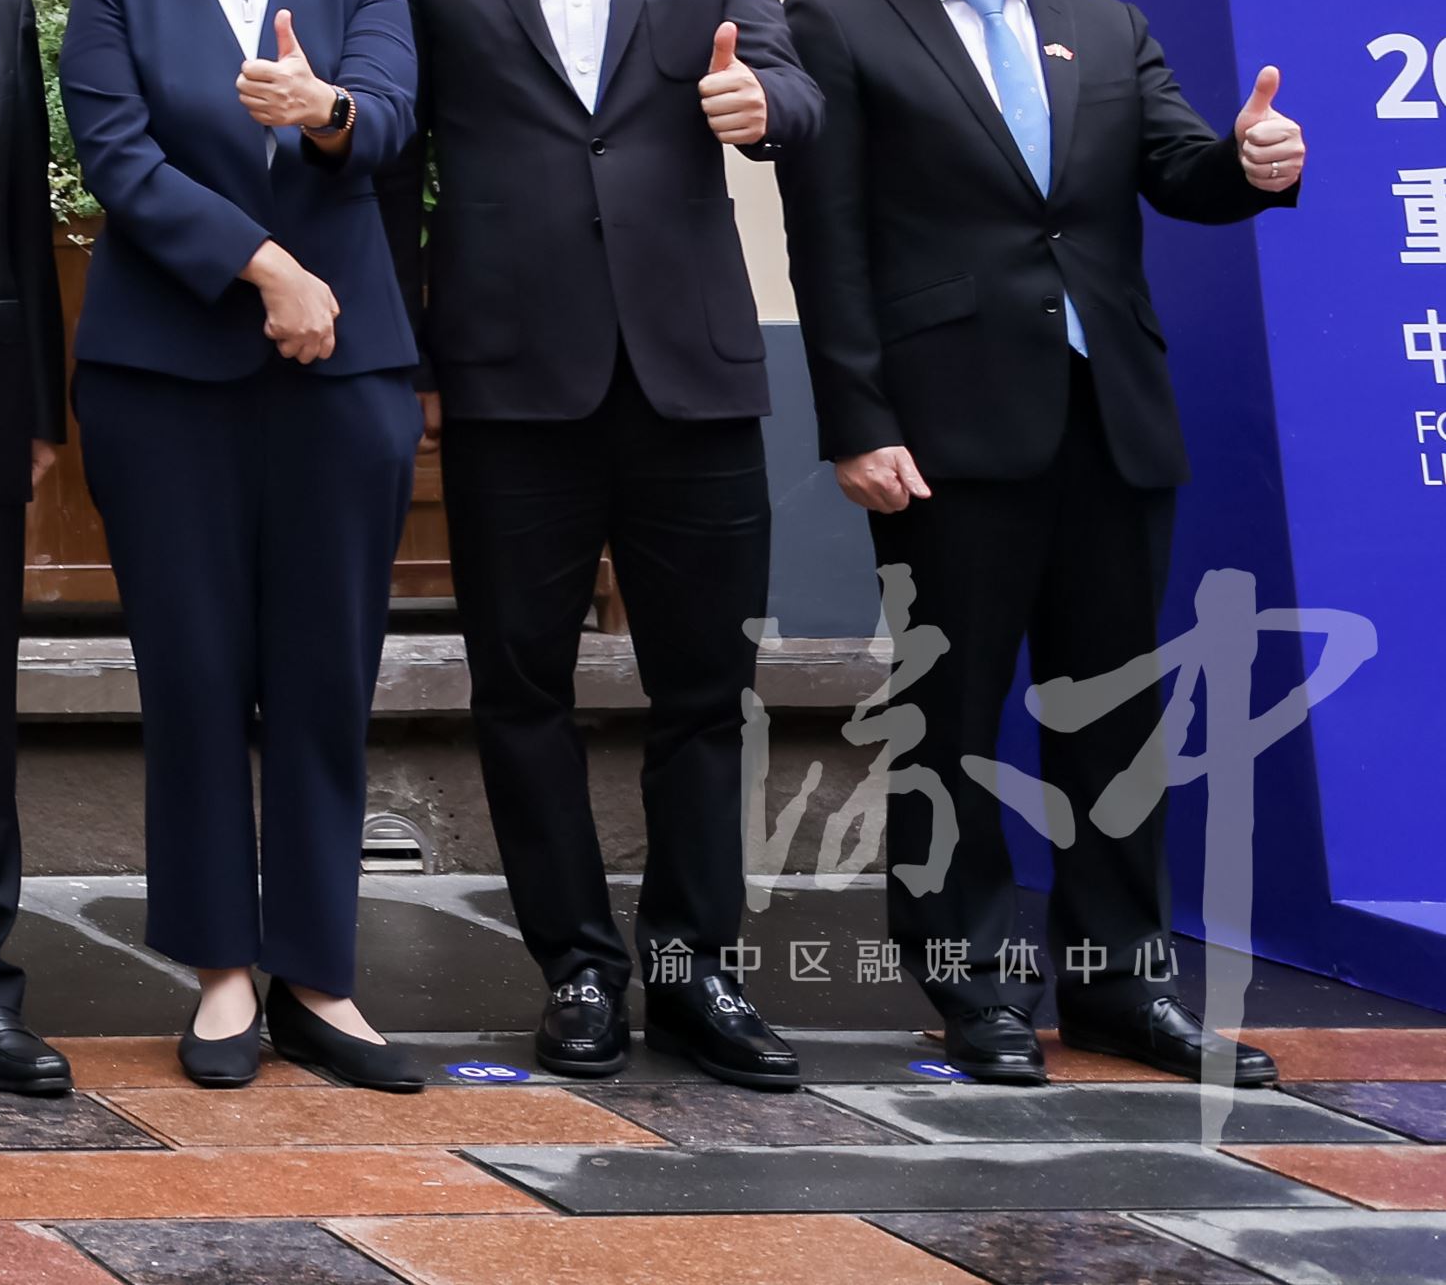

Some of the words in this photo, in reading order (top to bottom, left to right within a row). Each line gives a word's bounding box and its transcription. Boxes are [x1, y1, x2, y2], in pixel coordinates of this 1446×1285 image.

[1366, 32, 1446, 119] 2
[1415, 411, 1446, 444] F
[457, 1067, 517, 1078] 08
